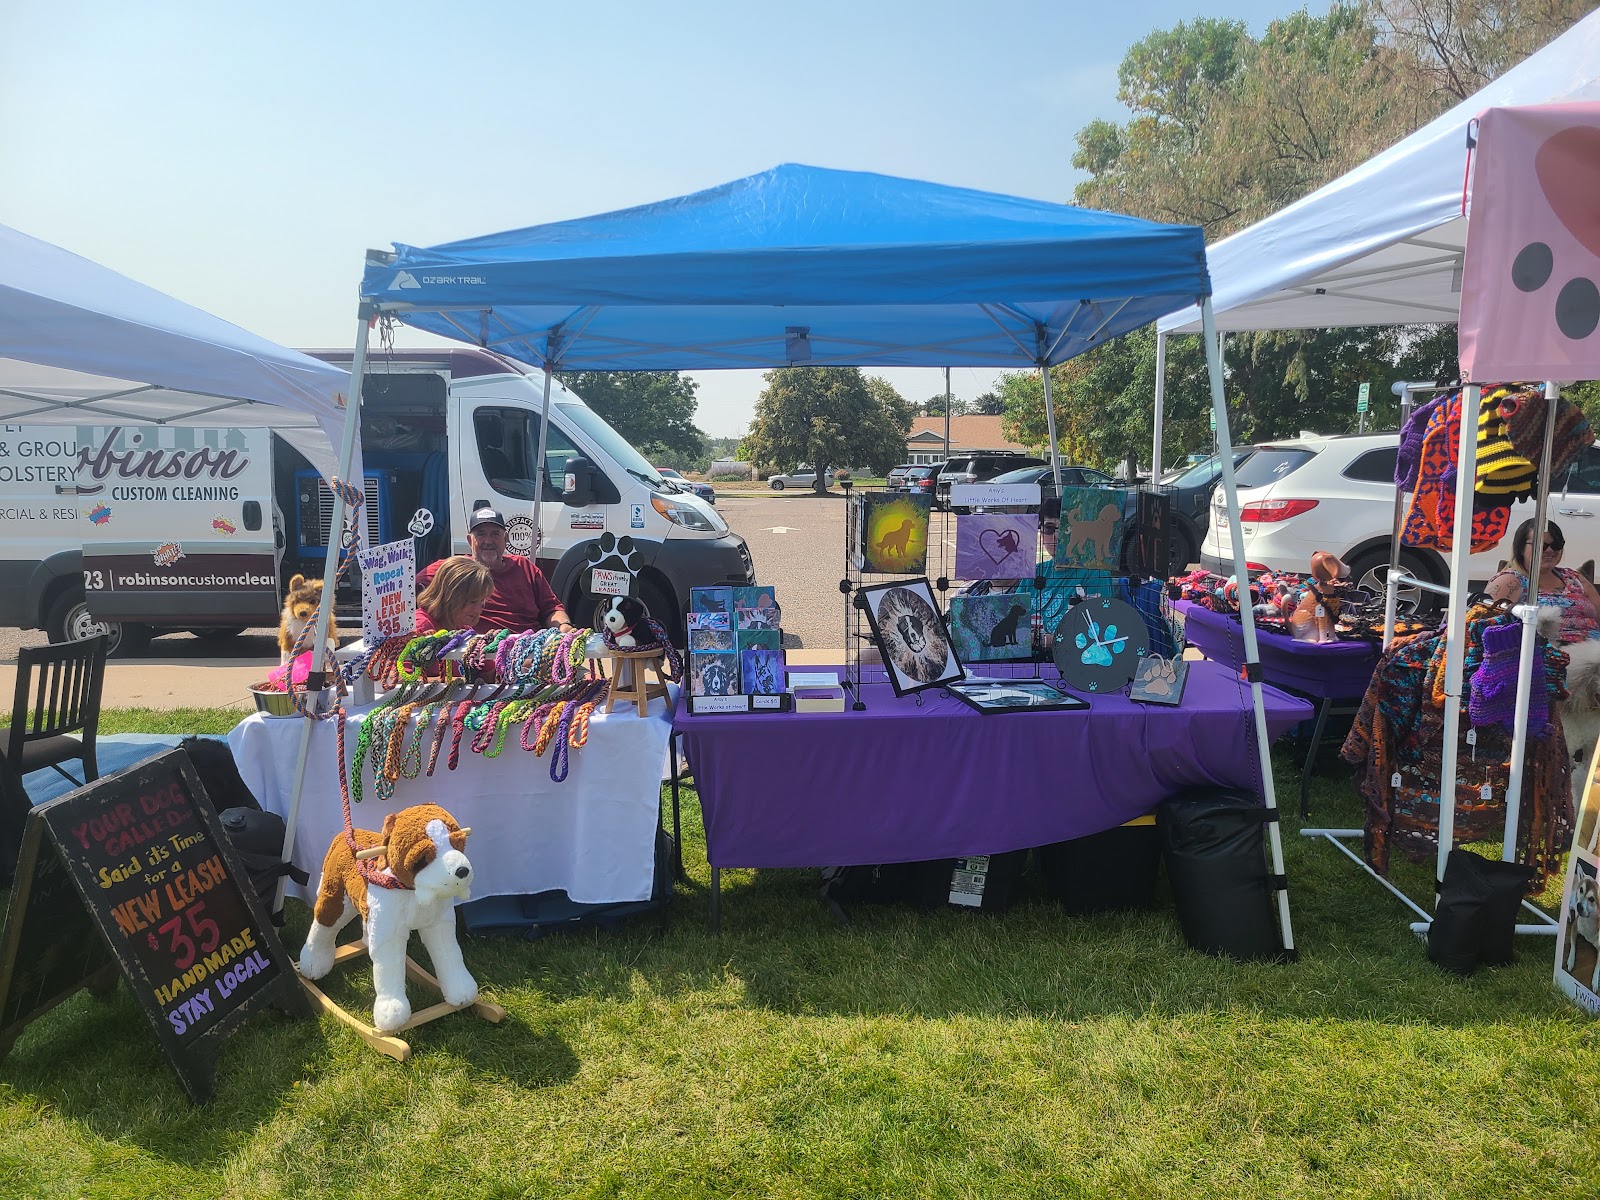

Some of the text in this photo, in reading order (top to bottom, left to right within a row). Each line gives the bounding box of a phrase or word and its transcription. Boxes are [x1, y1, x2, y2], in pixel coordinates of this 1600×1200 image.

[112, 486, 239, 501] CUSTOM CLEANING
[40, 508, 49, 520] &
[373, 565, 404, 586] Repeat
[600, 580, 618, 588] GREAT
[376, 579, 403, 595] with a
[381, 591, 402, 608] NEW
[375, 601, 406, 621] LEASH
[377, 616, 401, 637] $35
[71, 783, 185, 849] YOUR DOG
[98, 856, 142, 889] Said
[145, 844, 170, 866] it's
[168, 831, 206, 853] Time
[144, 860, 183, 885] for a
[110, 854, 228, 939] NEW LEASH
[153, 927, 257, 1006] HANDMADE
[168, 949, 271, 1035] STAY LOCAL
